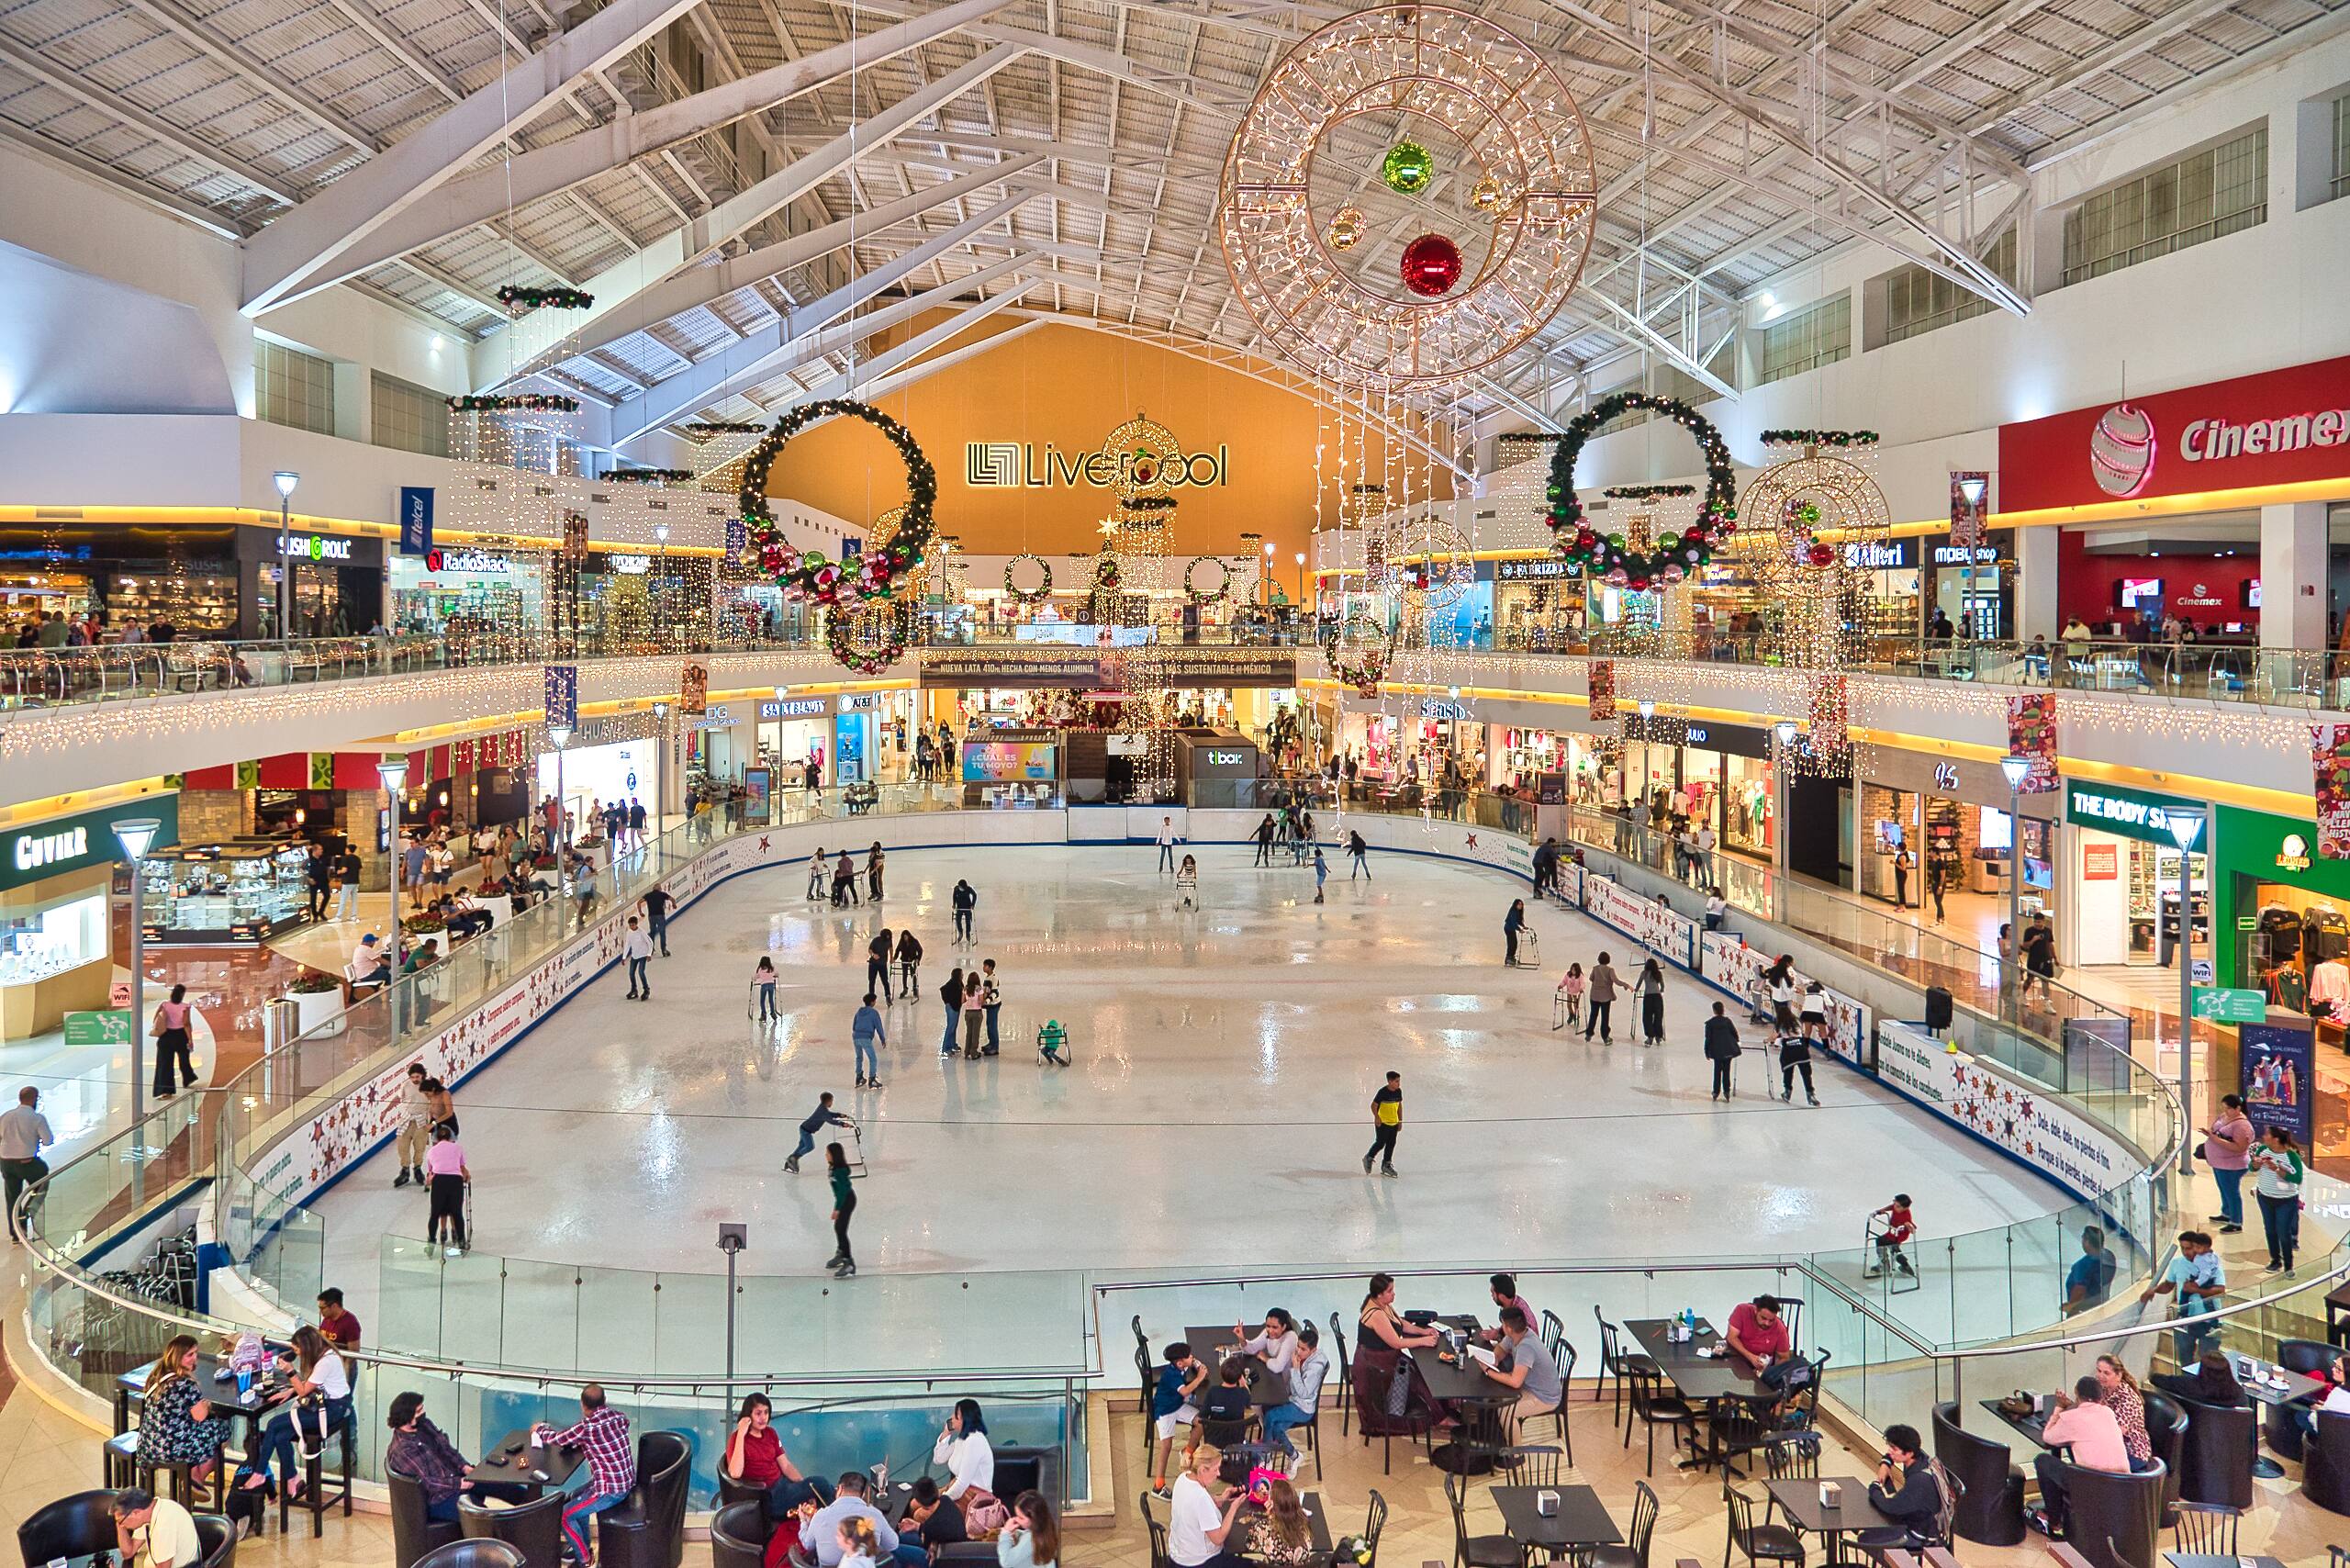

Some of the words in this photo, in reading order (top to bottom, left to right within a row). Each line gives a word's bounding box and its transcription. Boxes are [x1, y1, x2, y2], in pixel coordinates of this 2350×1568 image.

[1025, 442, 1227, 493] Liverpool
[410, 495, 424, 532] telcel
[278, 536, 310, 556] SUSHI
[322, 540, 351, 559] ROLL
[1975, 547, 1997, 563] shop
[442, 550, 512, 574] RadioShack
[2177, 597, 2222, 607] Cinemex
[940, 664, 963, 673] NUEVA
[965, 664, 981, 673] LATA
[1002, 664, 1023, 673] HECHA
[1024, 664, 1038, 673] CON
[1040, 664, 1062, 673] MENOS
[1063, 664, 1094, 673] ALUMINIO
[1183, 664, 1235, 674] SUSTENTABLE
[1244, 662, 1271, 674] MÉXICO
[852, 697, 872, 708] AT&T
[706, 706, 728, 720] DG
[583, 722, 627, 740] HUAWEI
[1688, 728, 1707, 742] JULIO
[971, 752, 1002, 763] ¿CUÁL
[1004, 755, 1017, 763] ES
[971, 762, 984, 770] TU
[985, 762, 1019, 770] MOYO?
[2073, 792, 2103, 817] THE
[2103, 798, 2148, 825] BODY
[2038, 1111, 2050, 1133] Dale,
[2051, 1117, 2062, 1139] dale,
[2063, 1124, 2074, 1147] dale,
[2038, 1141, 2054, 1167] Porque
